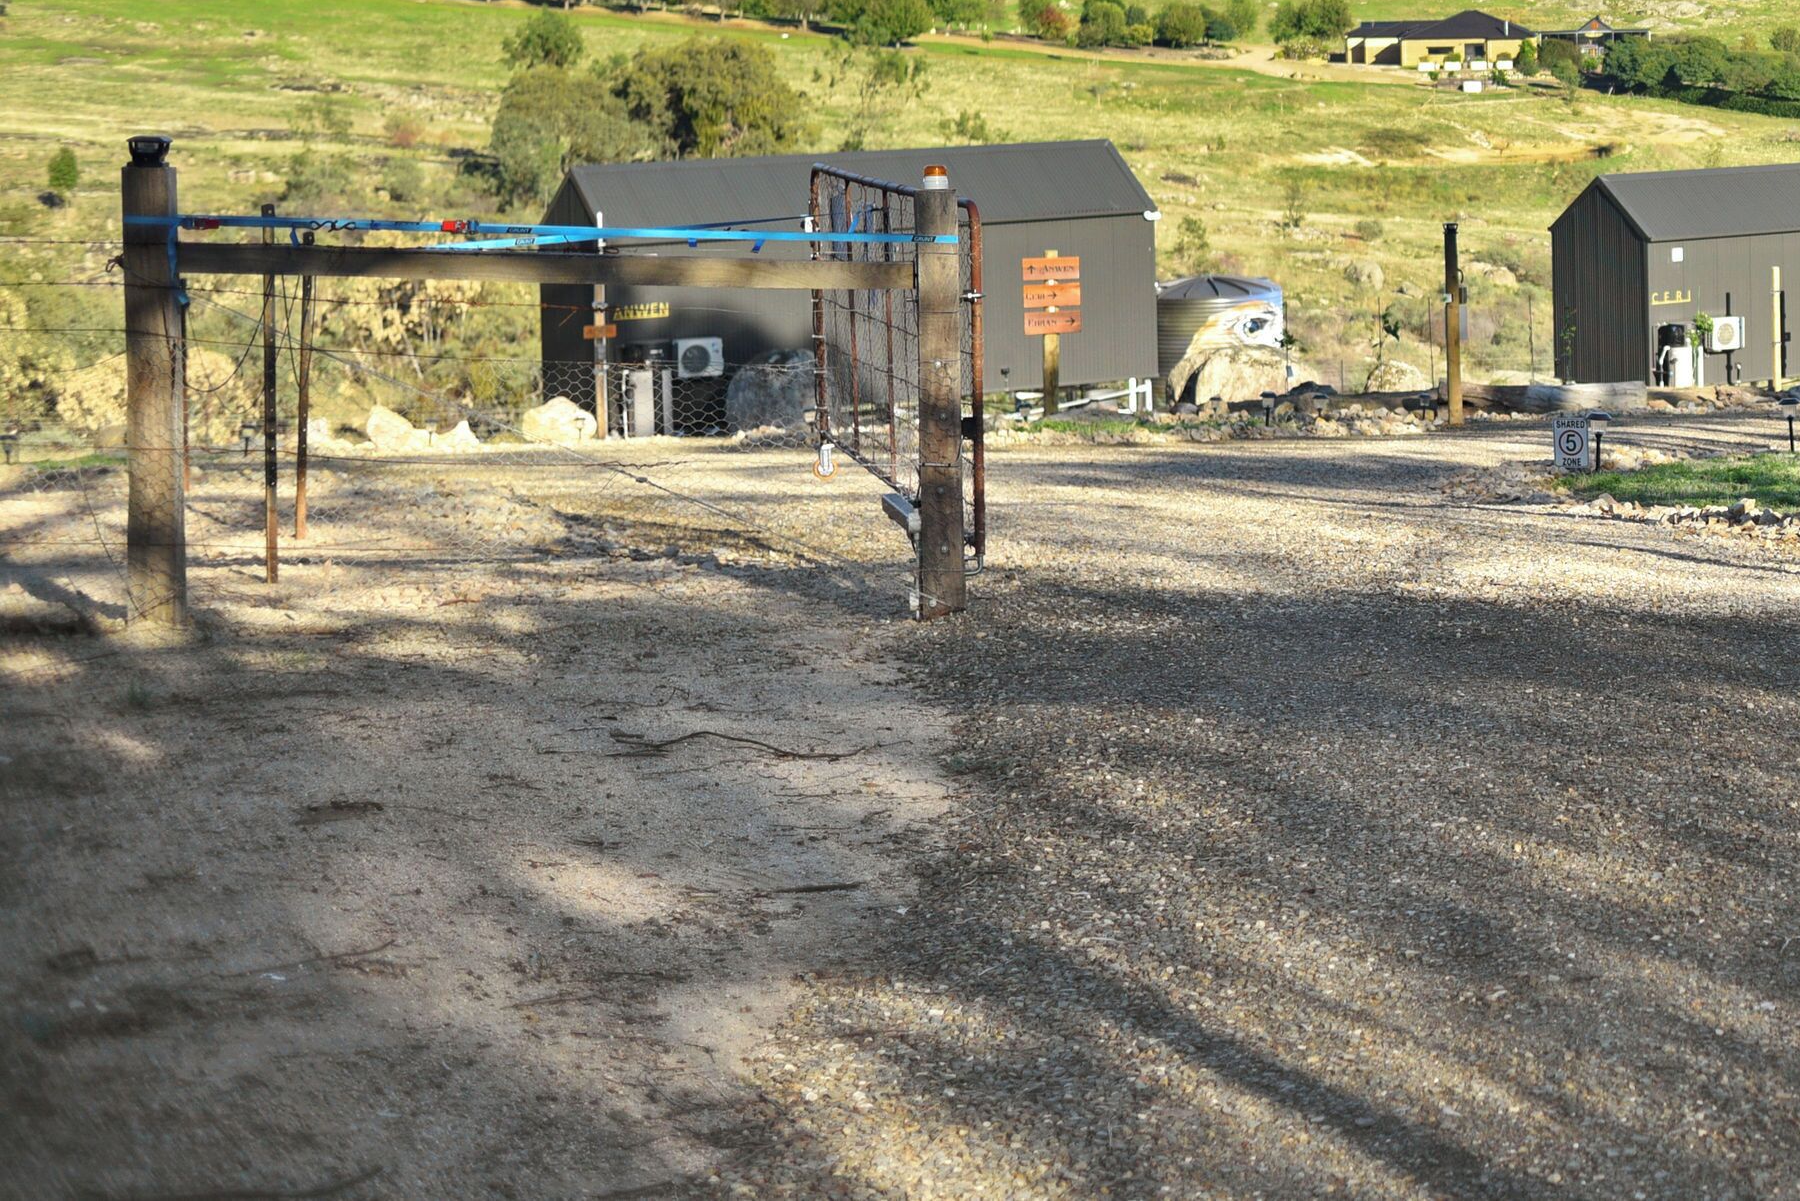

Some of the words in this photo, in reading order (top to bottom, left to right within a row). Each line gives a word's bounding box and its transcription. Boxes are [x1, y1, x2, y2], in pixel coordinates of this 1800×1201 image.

[1651, 289, 1692, 305] CERI
[613, 301, 670, 321] ANWEN
[1556, 420, 1585, 429] SHARED
[1566, 433, 1577, 452] 5
[1562, 458, 1582, 466] ZONE
